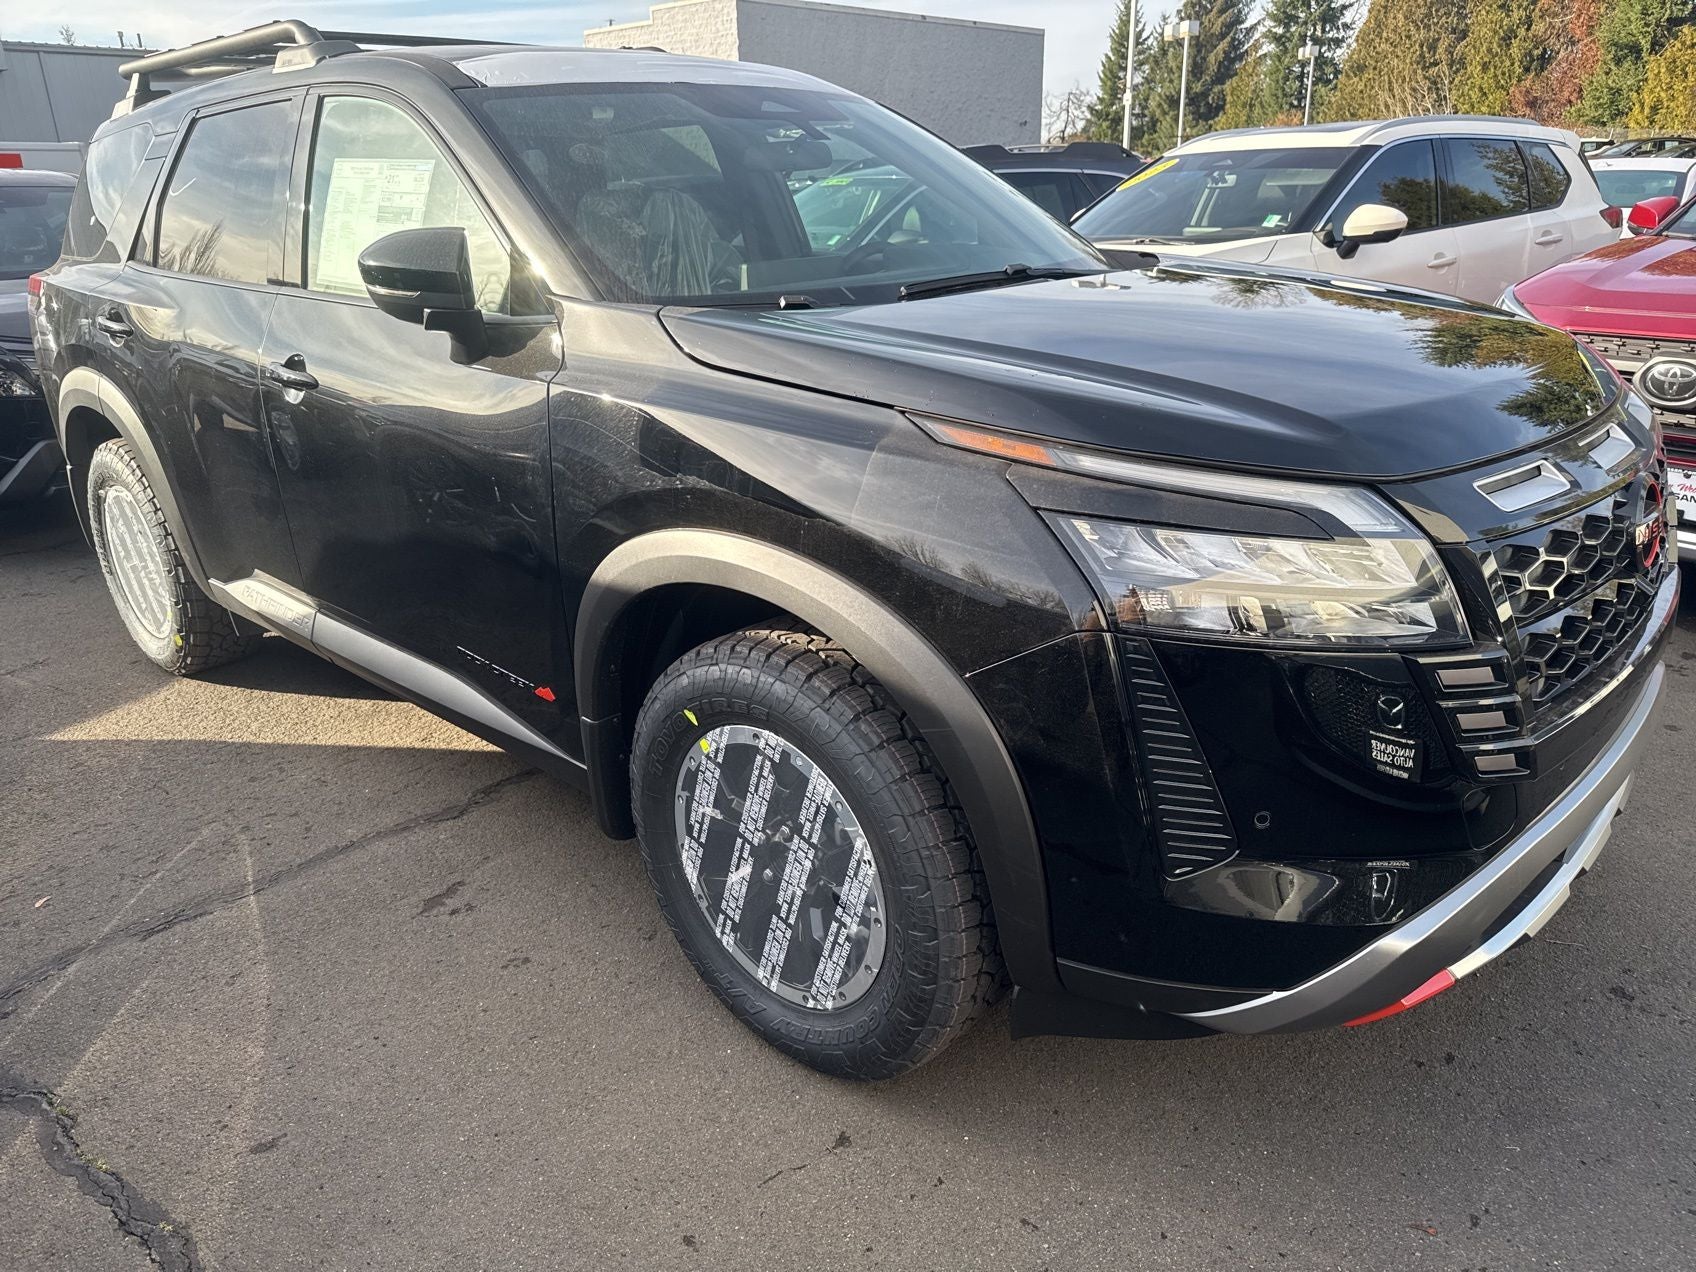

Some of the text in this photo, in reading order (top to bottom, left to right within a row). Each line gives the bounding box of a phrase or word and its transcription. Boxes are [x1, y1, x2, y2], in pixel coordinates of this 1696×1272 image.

[758, 737, 766, 751] FOR
[765, 745, 773, 757] DO
[773, 743, 781, 762] UNTIL
[741, 792, 752, 823] CUSTOMER
[744, 759, 770, 841] DO NOT REMOVE WHEEL MASK
[801, 775, 826, 838] REMOVE WHEEL MASK
[756, 799, 767, 830] CUSTOMER
[742, 842, 750, 859] MASK
[806, 846, 814, 860] FOR
[779, 839, 808, 919] DO NOT REMOVE WHEEL MASK
[782, 850, 795, 881] CUSTOMER
[838, 875, 852, 906] CUSTOMER
[841, 913, 851, 925] DO
[847, 877, 862, 904] REMOVE
[835, 905, 843, 918] FOR
[837, 926, 847, 945] MASK
[831, 943, 841, 963] WHEEL
[822, 958, 836, 984] REMOVE
[829, 965, 842, 996] CUSTOMER
[818, 980, 829, 996] NOT
[770, 1004, 880, 1046] COUNTRY
